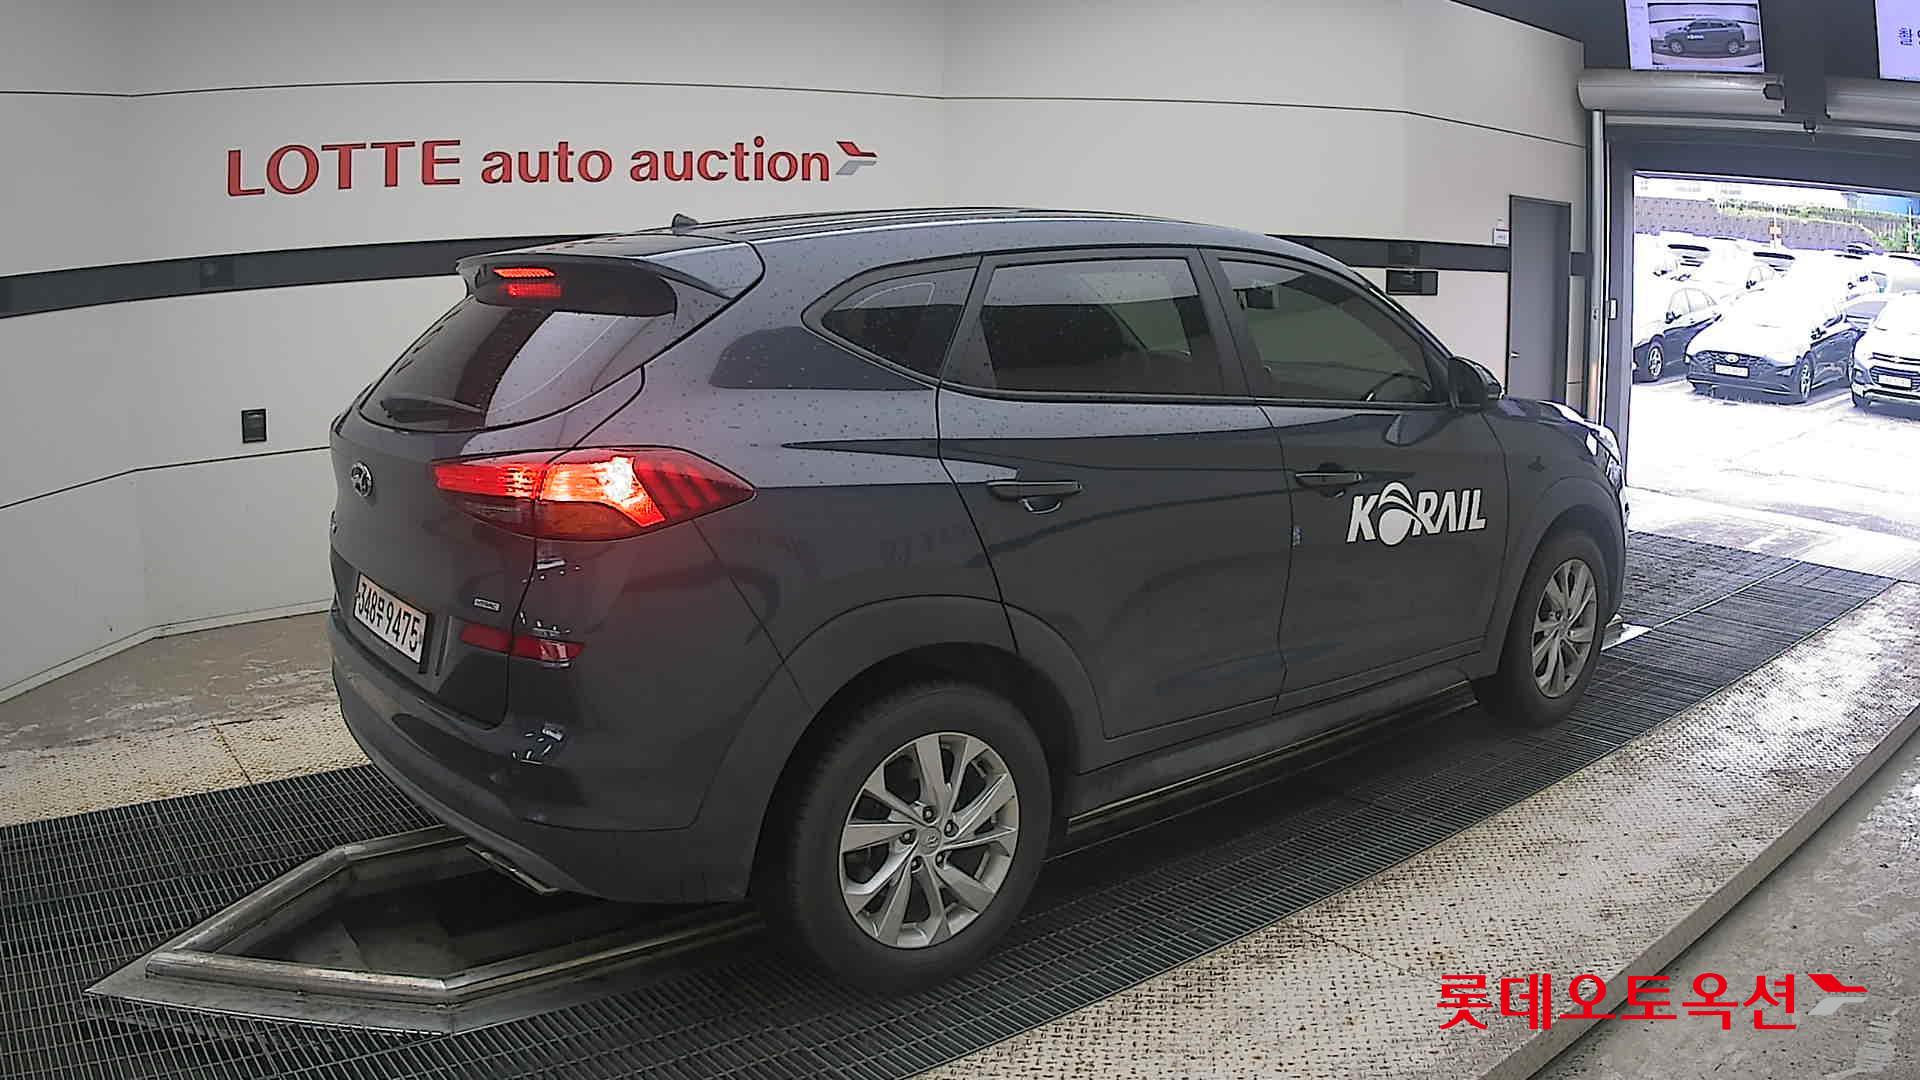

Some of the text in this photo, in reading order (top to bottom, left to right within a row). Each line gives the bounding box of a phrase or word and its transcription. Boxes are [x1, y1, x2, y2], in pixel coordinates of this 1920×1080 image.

[227, 136, 830, 197] LOTTE auto auction
[1347, 481, 1487, 546] KORAIL
